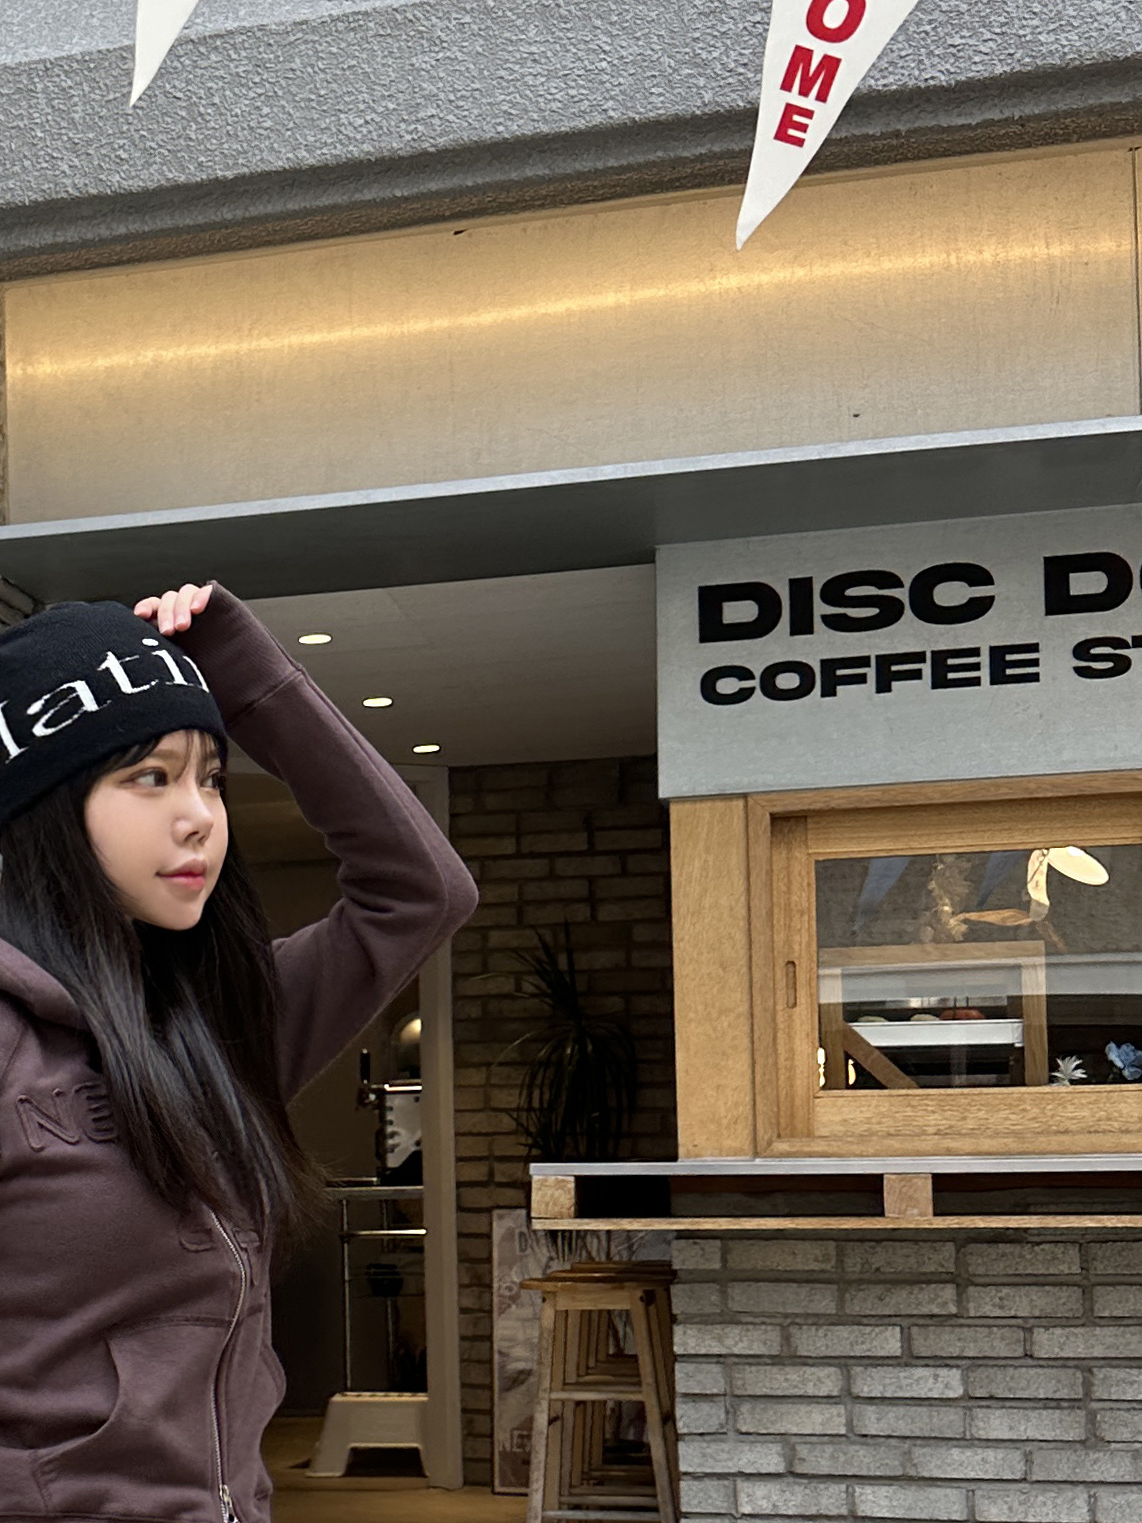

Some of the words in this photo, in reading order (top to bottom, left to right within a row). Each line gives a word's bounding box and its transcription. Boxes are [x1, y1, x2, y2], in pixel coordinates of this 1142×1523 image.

[698, 562, 996, 643] DISC
[1044, 551, 1142, 616] D
[700, 642, 1040, 706] COFFEE
[1072, 635, 1142, 679] S
